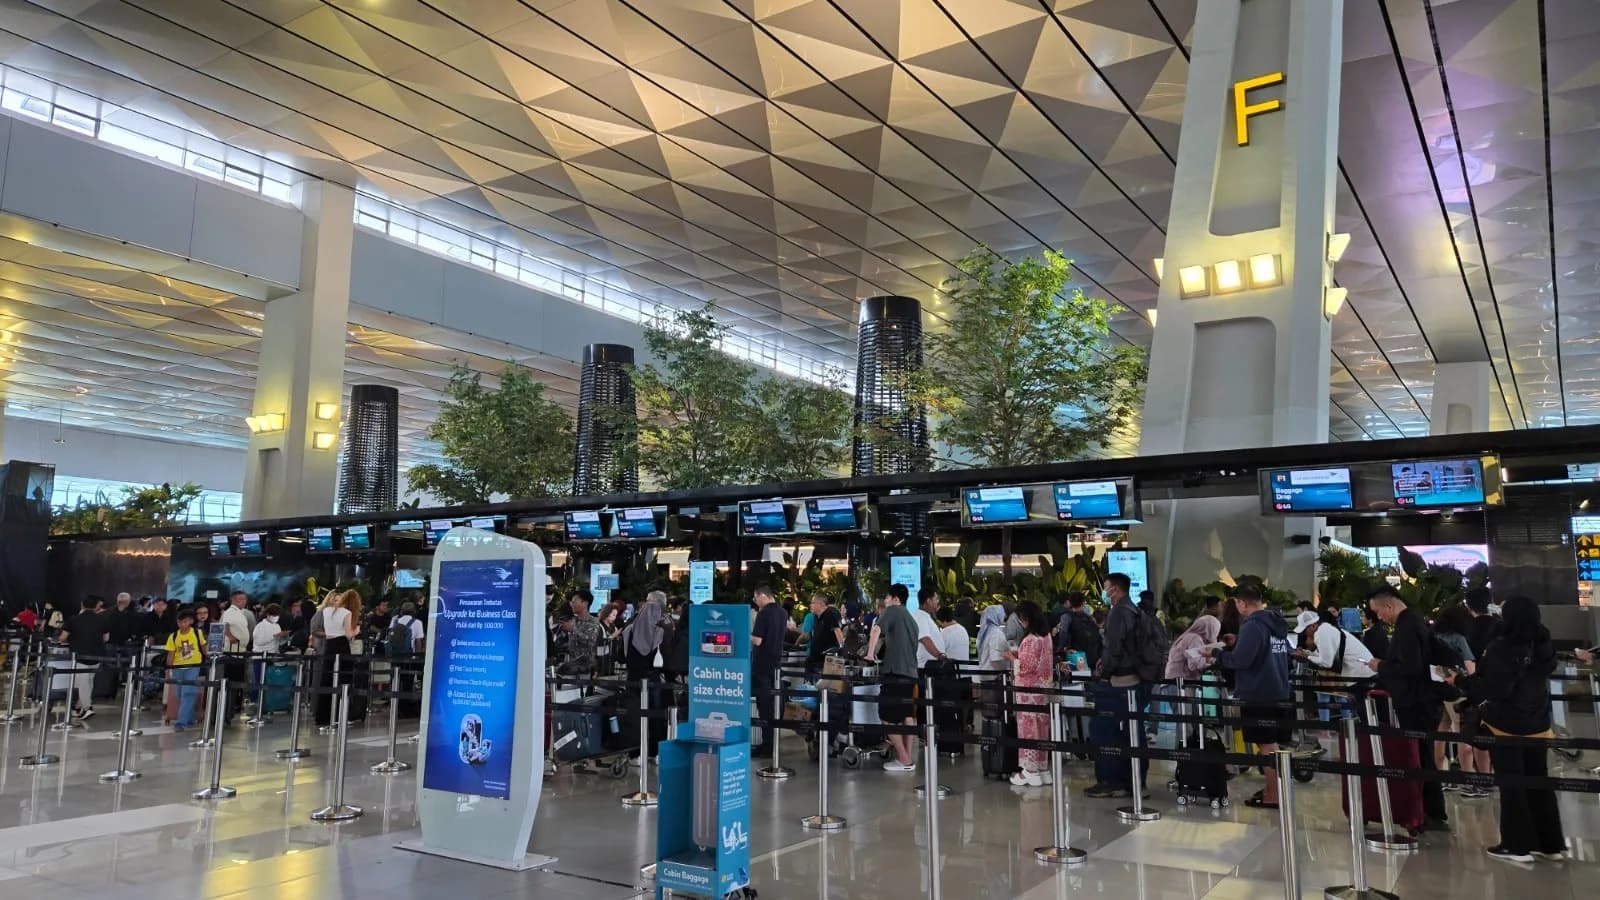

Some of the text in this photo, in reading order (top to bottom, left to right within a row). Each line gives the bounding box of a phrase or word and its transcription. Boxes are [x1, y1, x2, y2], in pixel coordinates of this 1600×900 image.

[1234, 71, 1283, 145] F
[476, 610, 501, 618] Business
[501, 610, 517, 618] Class
[693, 667, 744, 684] Cabin bag
[693, 684, 744, 697] size check
[663, 868, 681, 878] Cabin
[681, 871, 709, 885] Baggage
